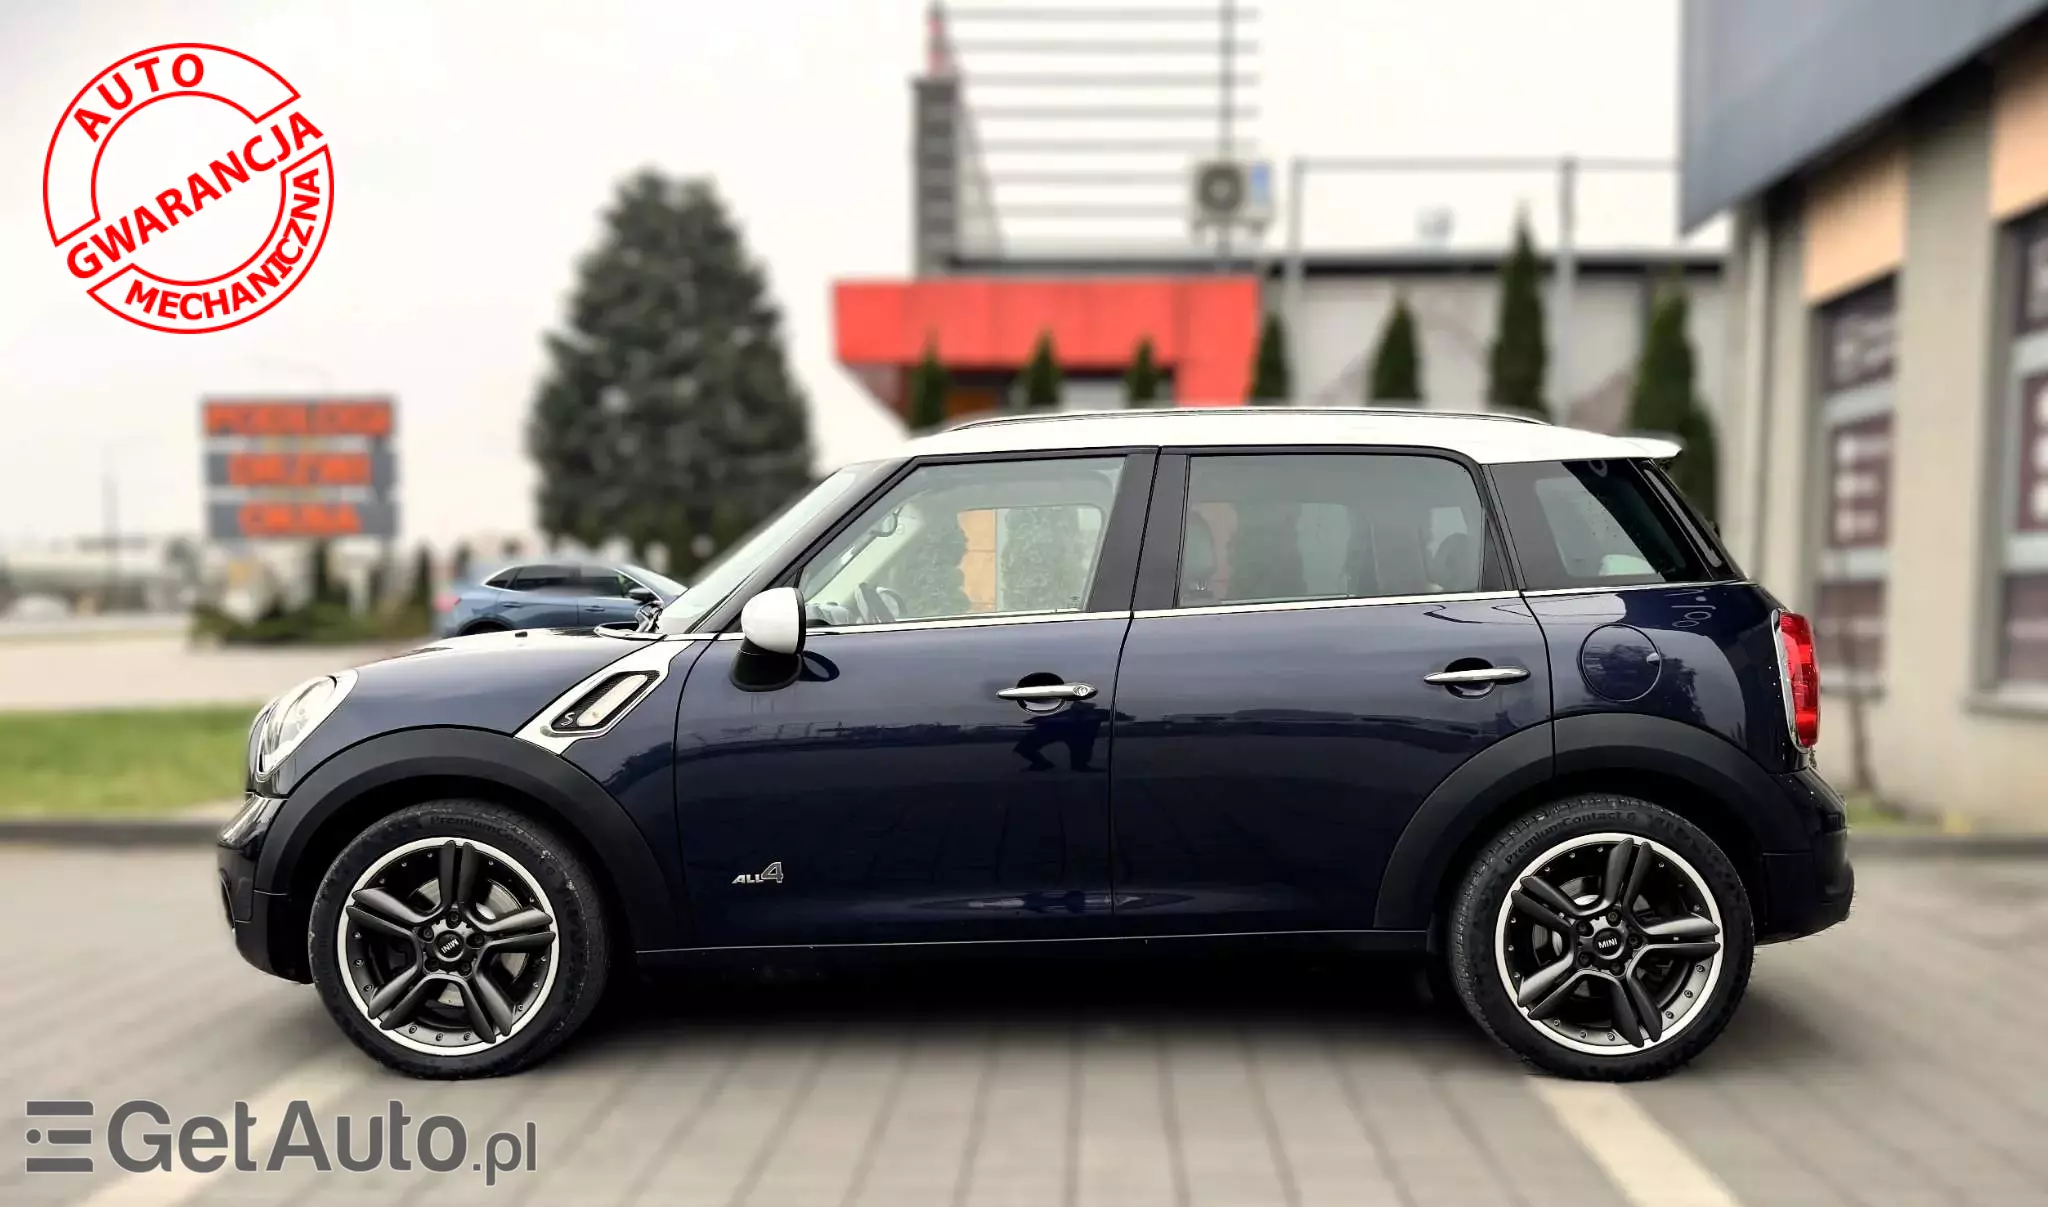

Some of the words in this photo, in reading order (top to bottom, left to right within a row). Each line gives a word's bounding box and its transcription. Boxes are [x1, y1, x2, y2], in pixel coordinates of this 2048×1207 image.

[560, 711, 576, 726] S
[440, 938, 460, 954] MINI
[1598, 937, 1618, 949] MINI
